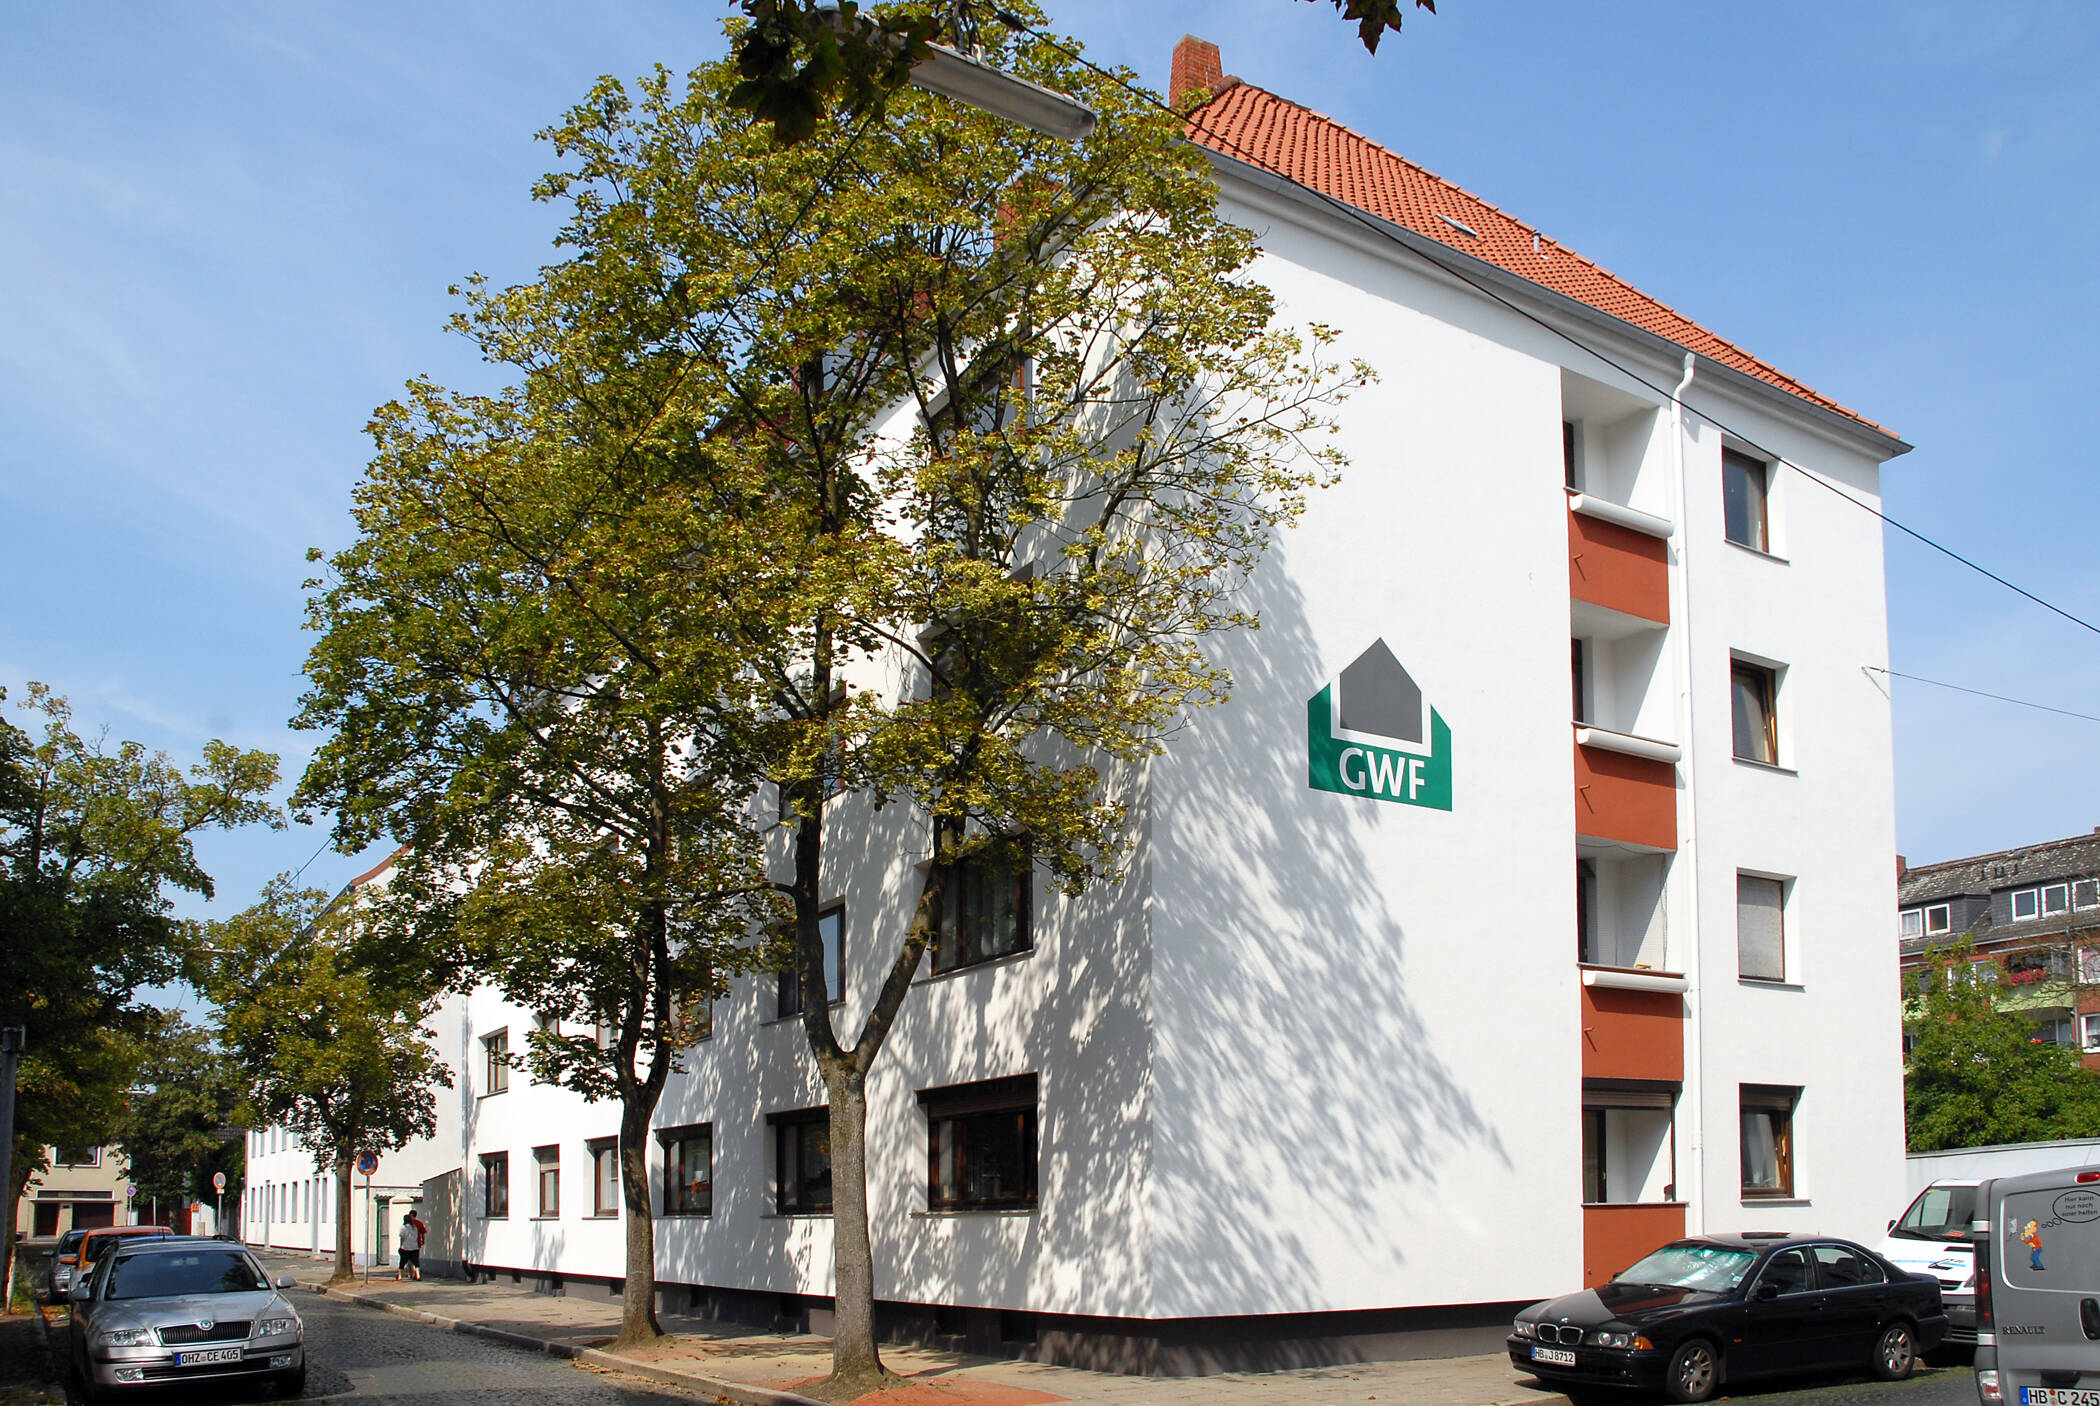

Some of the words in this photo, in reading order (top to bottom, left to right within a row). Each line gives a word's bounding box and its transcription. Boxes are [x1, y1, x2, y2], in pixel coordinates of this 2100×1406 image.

[1339, 747, 1425, 800] GWF
[2002, 1326, 2045, 1335] RENAULT
[181, 1352, 200, 1364] OHZ
[2028, 1389, 2048, 1405] HB
